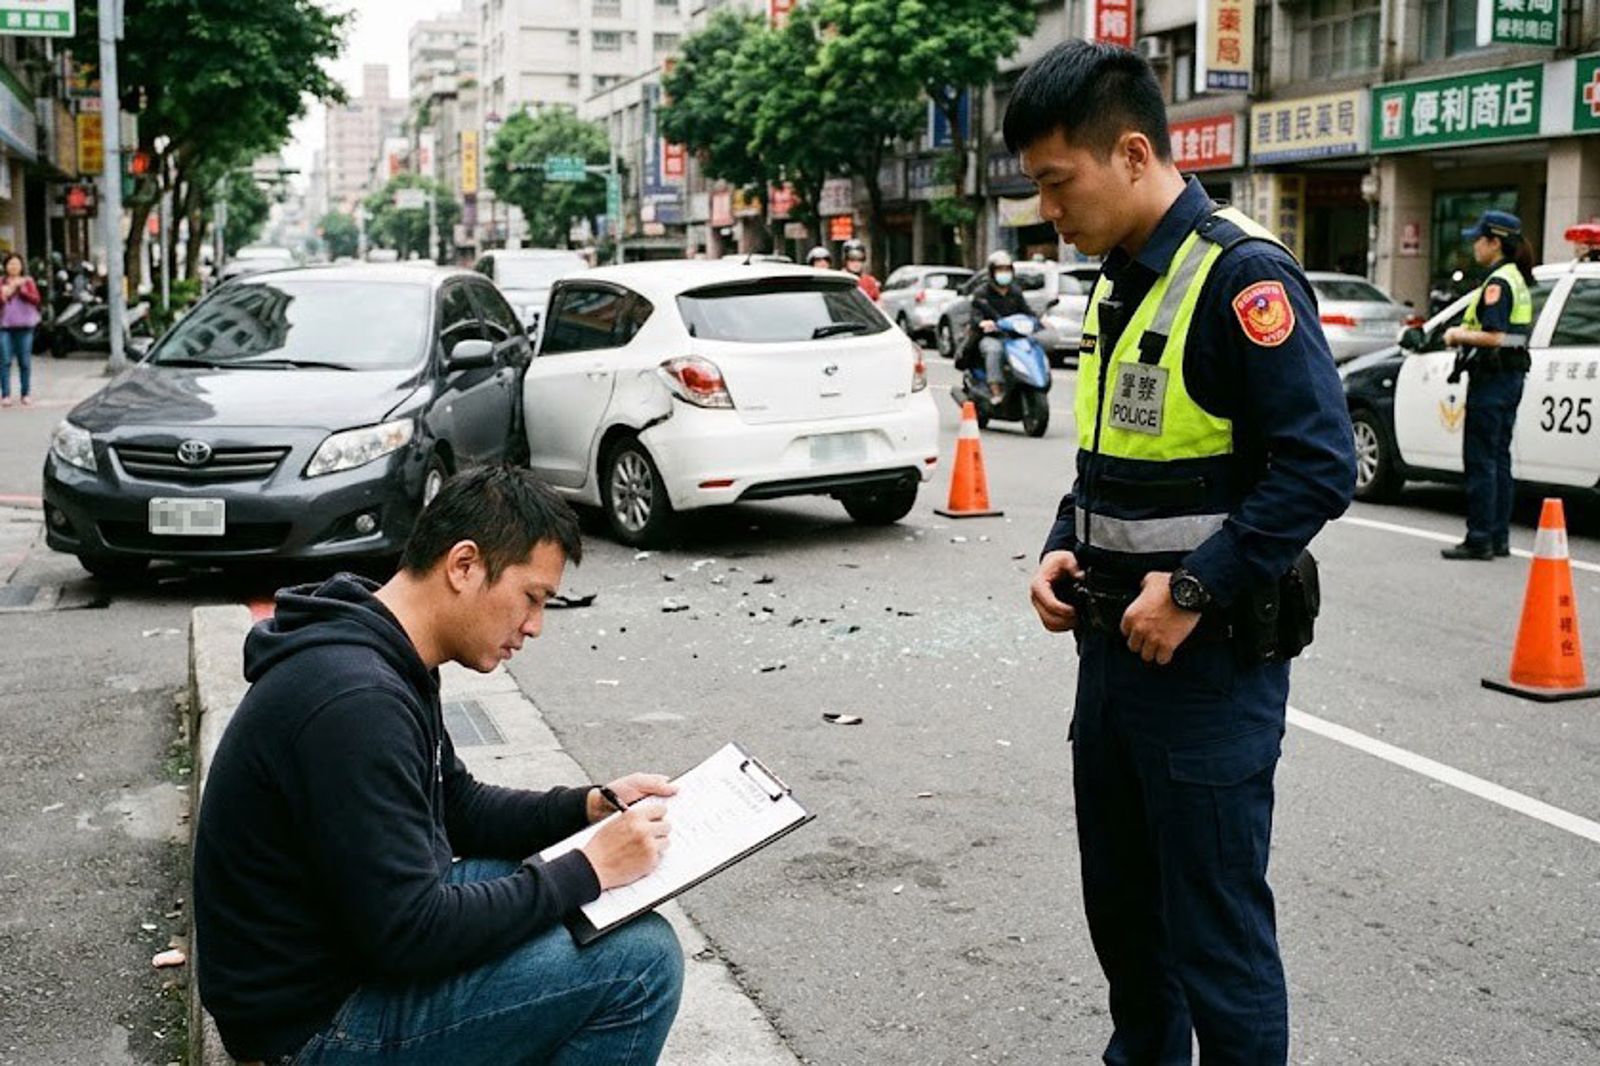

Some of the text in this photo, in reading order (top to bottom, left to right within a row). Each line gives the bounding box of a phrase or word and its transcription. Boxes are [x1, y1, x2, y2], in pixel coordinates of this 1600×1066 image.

[1217, 0, 1241, 64] 藥局
[1496, 17, 1554, 40] 便利商店
[1412, 78, 1535, 136] 便利商店
[1113, 404, 1158, 427] POLICE
[1541, 395, 1592, 434] 325
